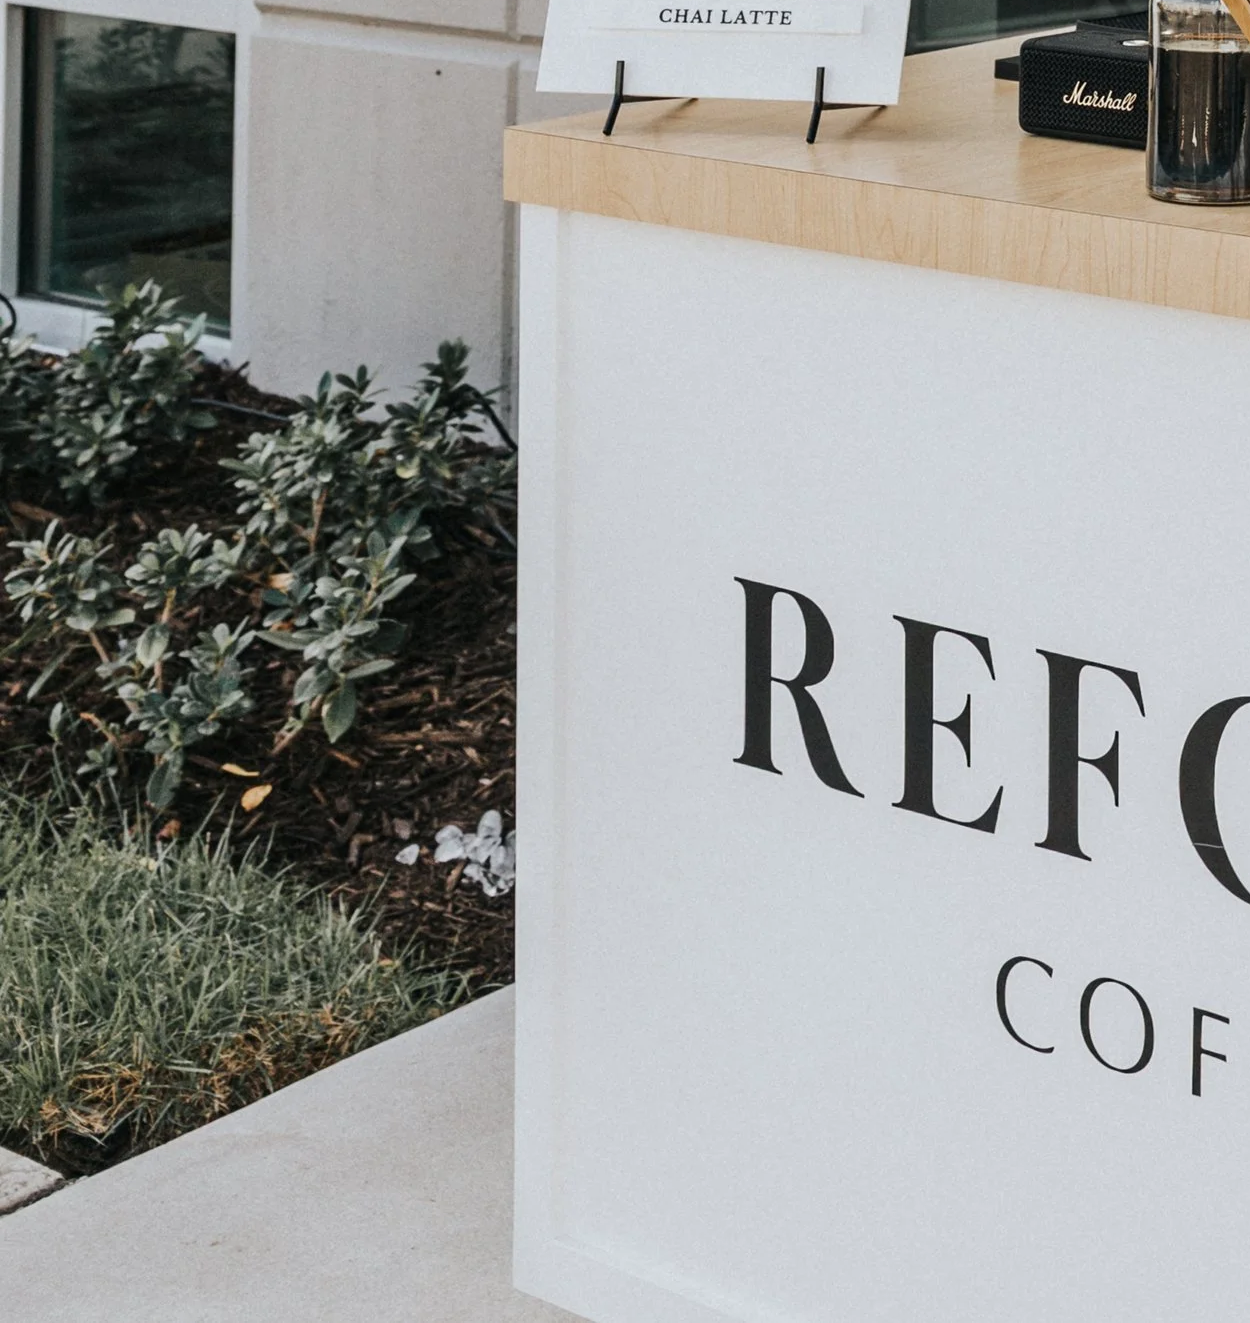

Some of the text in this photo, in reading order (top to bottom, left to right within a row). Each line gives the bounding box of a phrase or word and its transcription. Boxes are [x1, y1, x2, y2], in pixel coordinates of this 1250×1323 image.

[659, 8, 792, 26] CHAI LATTE
[1062, 80, 1137, 112] Marshall
